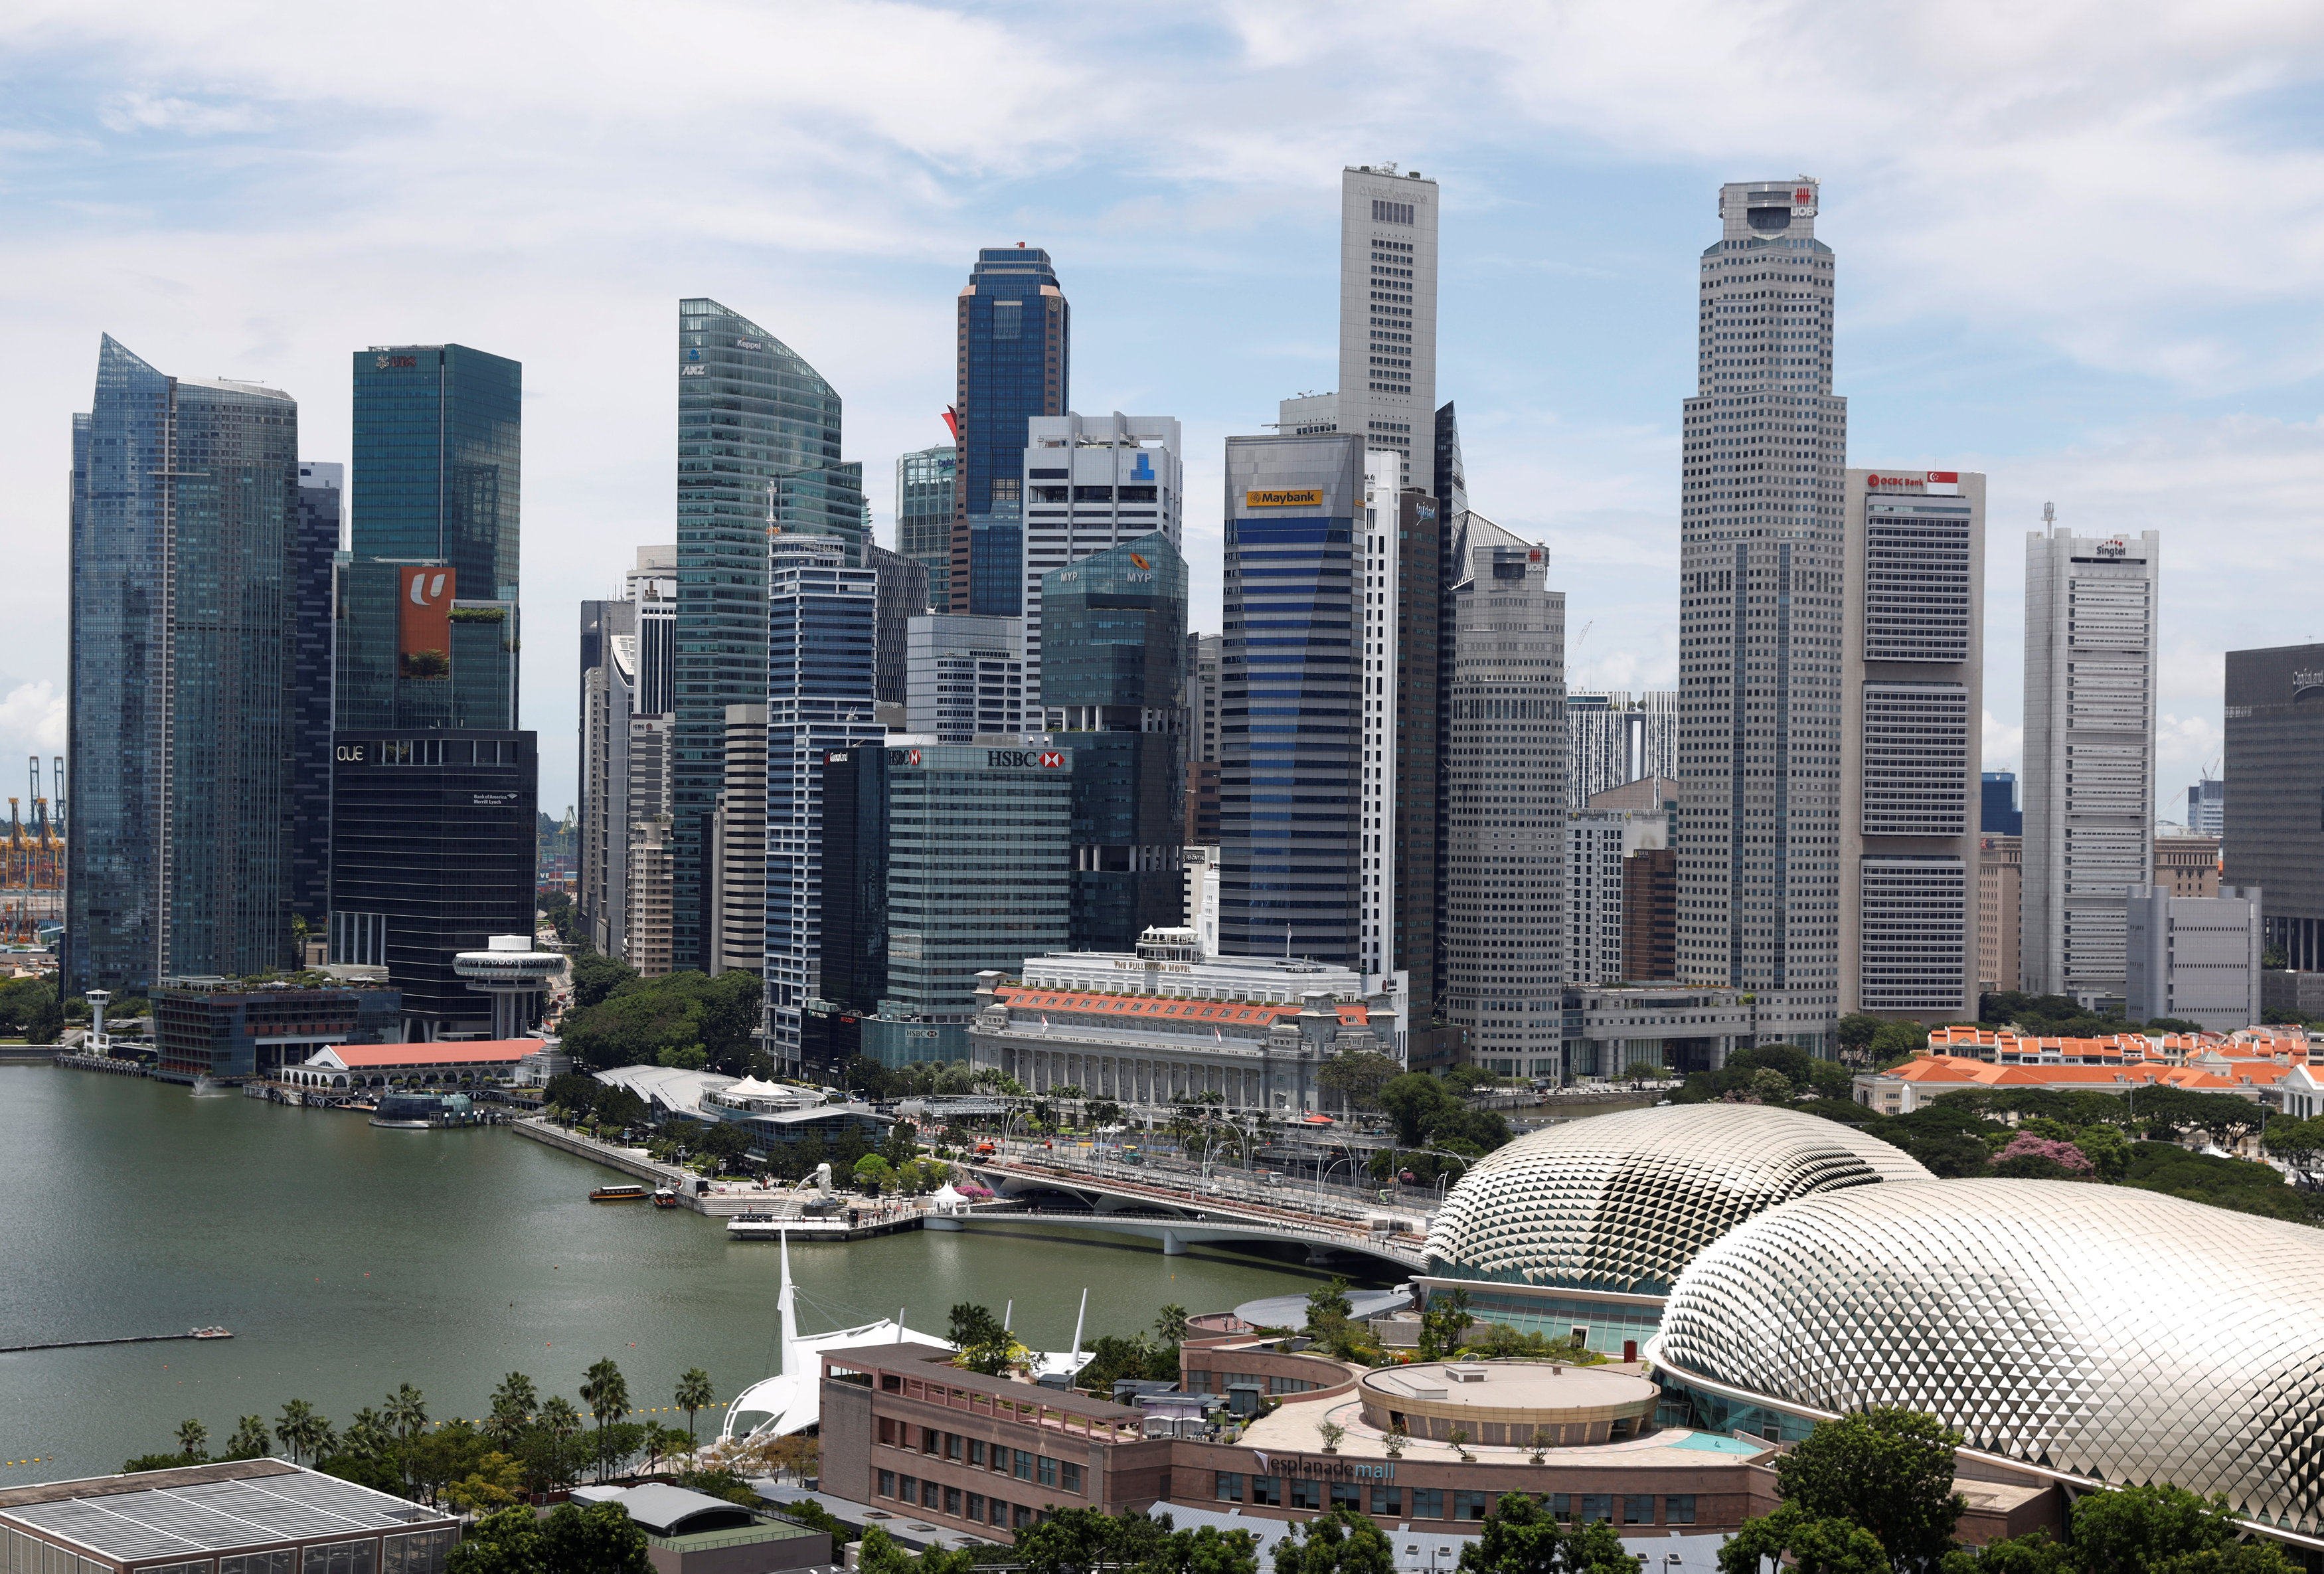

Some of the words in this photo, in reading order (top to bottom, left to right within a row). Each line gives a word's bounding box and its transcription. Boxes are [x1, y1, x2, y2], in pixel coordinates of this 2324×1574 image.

[1791, 207, 1814, 217] UOB
[736, 339, 762, 350] Keppel
[681, 365, 705, 376] ANZ
[1262, 492, 1315, 504] Maybank
[2096, 545, 2125, 557] Singtel
[1526, 563, 1544, 572] UOB
[1060, 572, 1078, 582] MYP
[1127, 573, 1152, 582] MYP
[337, 746, 364, 761] OUE
[888, 750, 910, 765] HSBC
[988, 750, 1037, 766] HSBC
[1114, 960, 1127, 970] THE
[1129, 961, 1167, 972] FULLERTON
[1169, 963, 1192, 974] HOTEL
[1270, 1455, 1353, 1476] esplanade
[1355, 1461, 1394, 1479] mall
